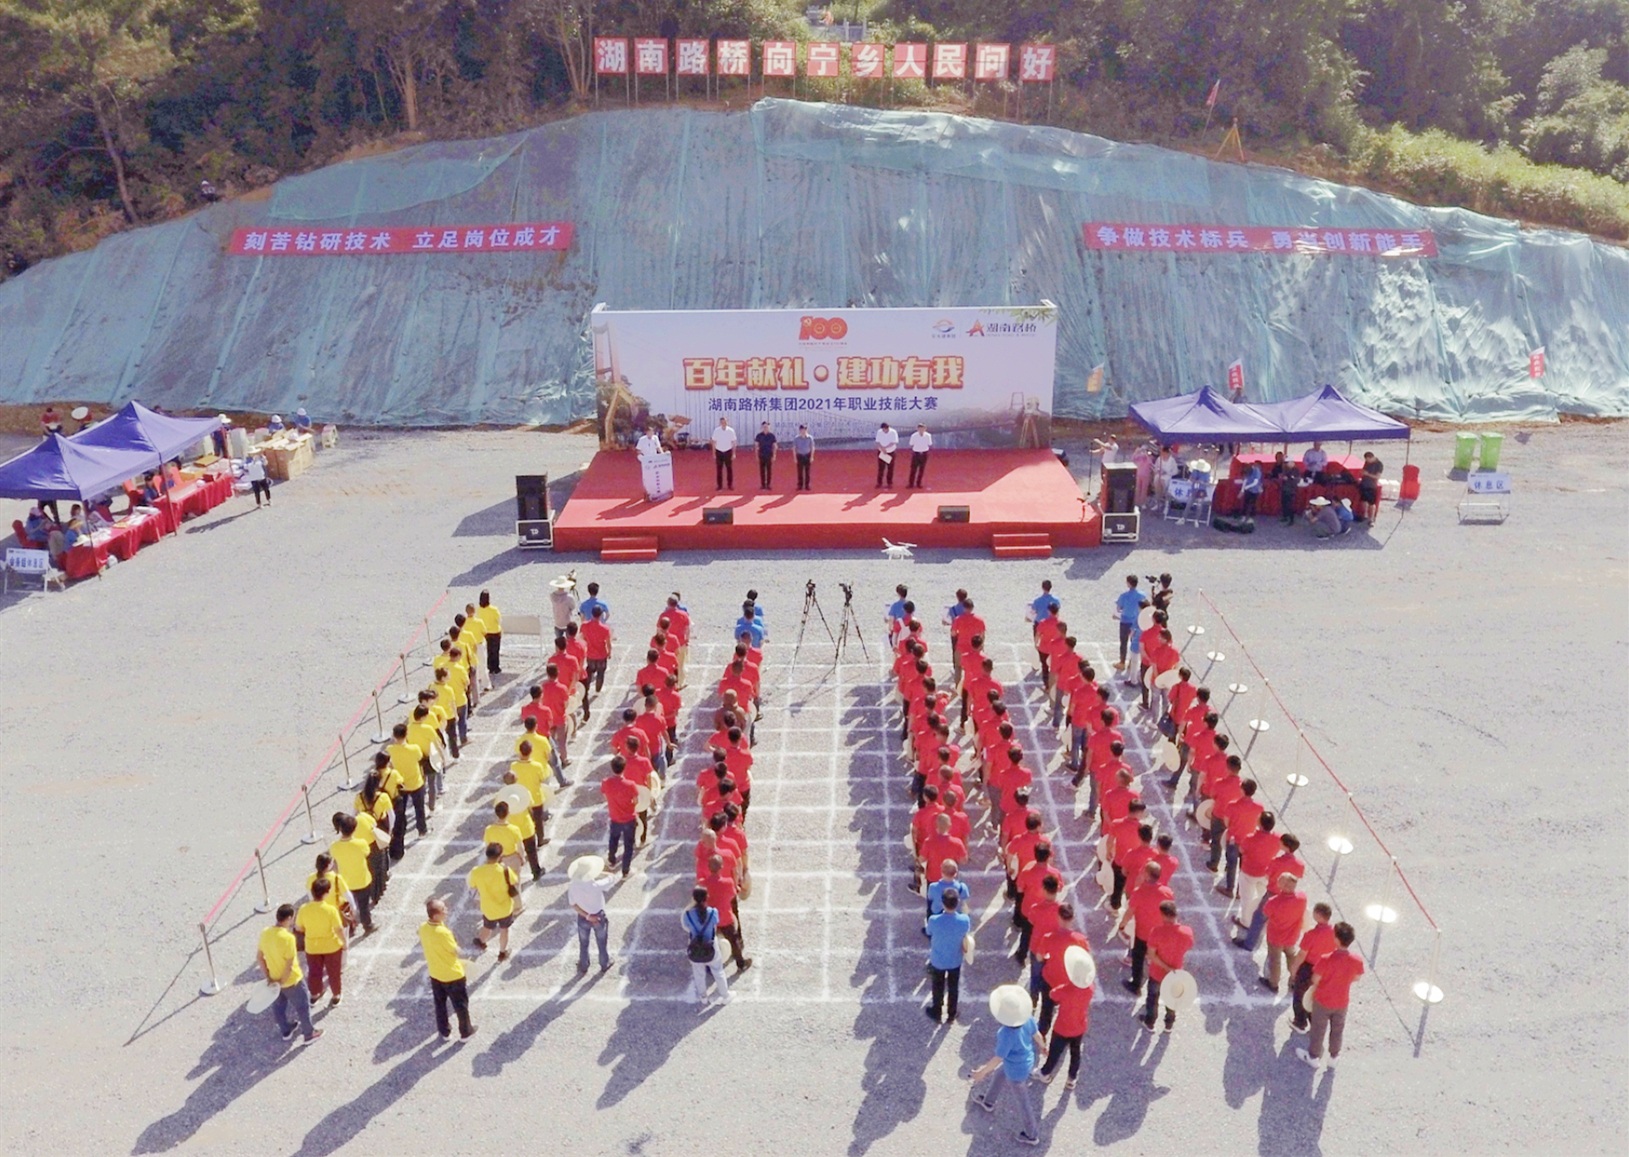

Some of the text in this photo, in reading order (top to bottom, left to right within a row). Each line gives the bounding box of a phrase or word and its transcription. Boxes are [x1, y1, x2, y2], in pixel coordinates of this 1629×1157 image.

[598, 40, 1052, 78] 湖南路桥向宁乡人民问好
[243, 226, 560, 251] 刻苦钻研技术 立足岗位成才
[1097, 226, 1249, 248] 争做技术标兵
[683, 356, 964, 390] 百年献礼·建功有我
[708, 396, 938, 411] 湖南路桥集团2021年职业技能大赛
